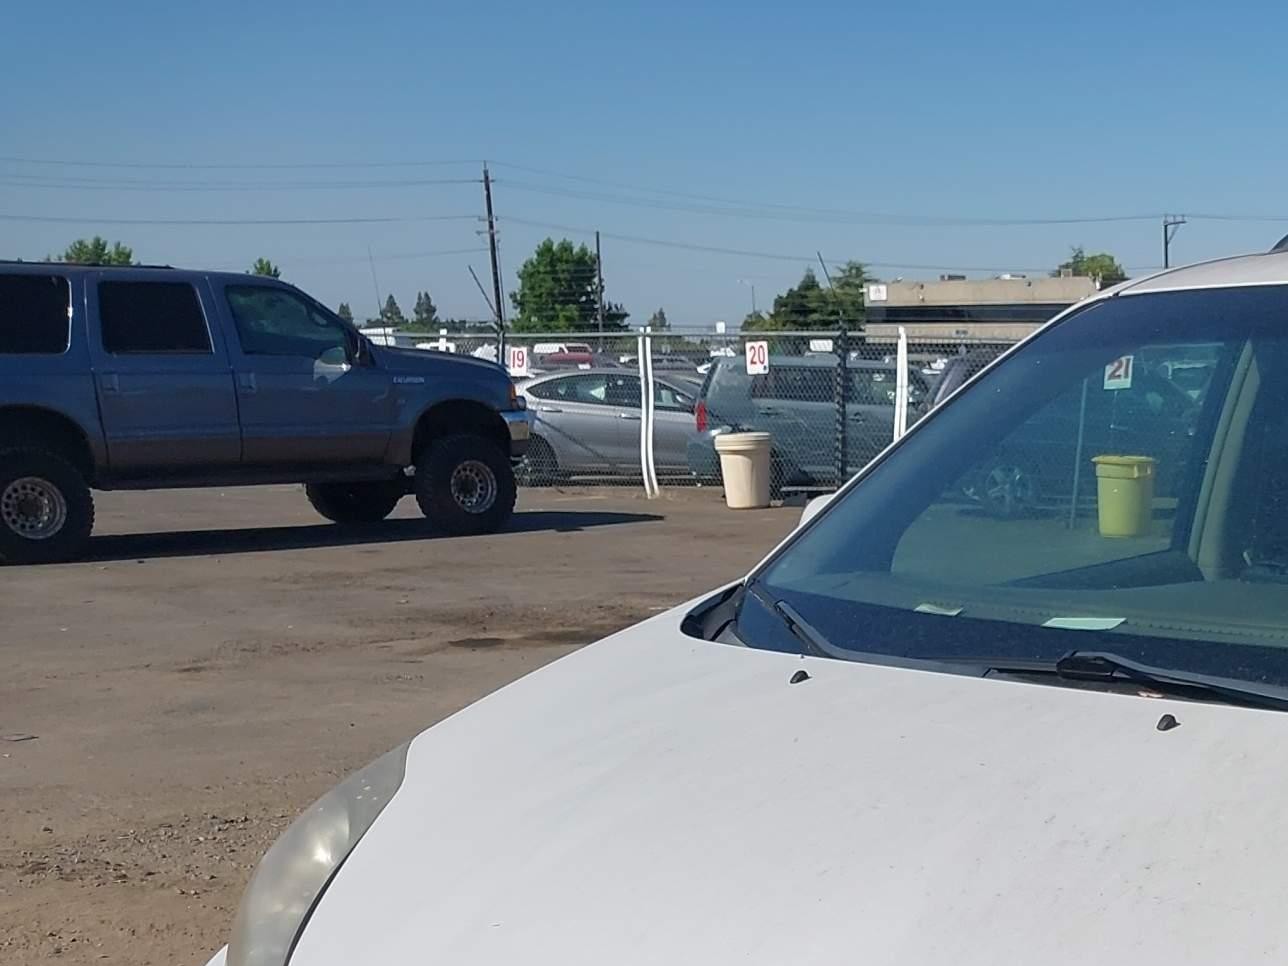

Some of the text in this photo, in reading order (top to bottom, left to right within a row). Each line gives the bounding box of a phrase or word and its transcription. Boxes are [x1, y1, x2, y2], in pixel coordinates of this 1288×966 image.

[512, 350, 525, 368] 19
[749, 345, 766, 365] 20
[1107, 358, 1131, 381] 21
